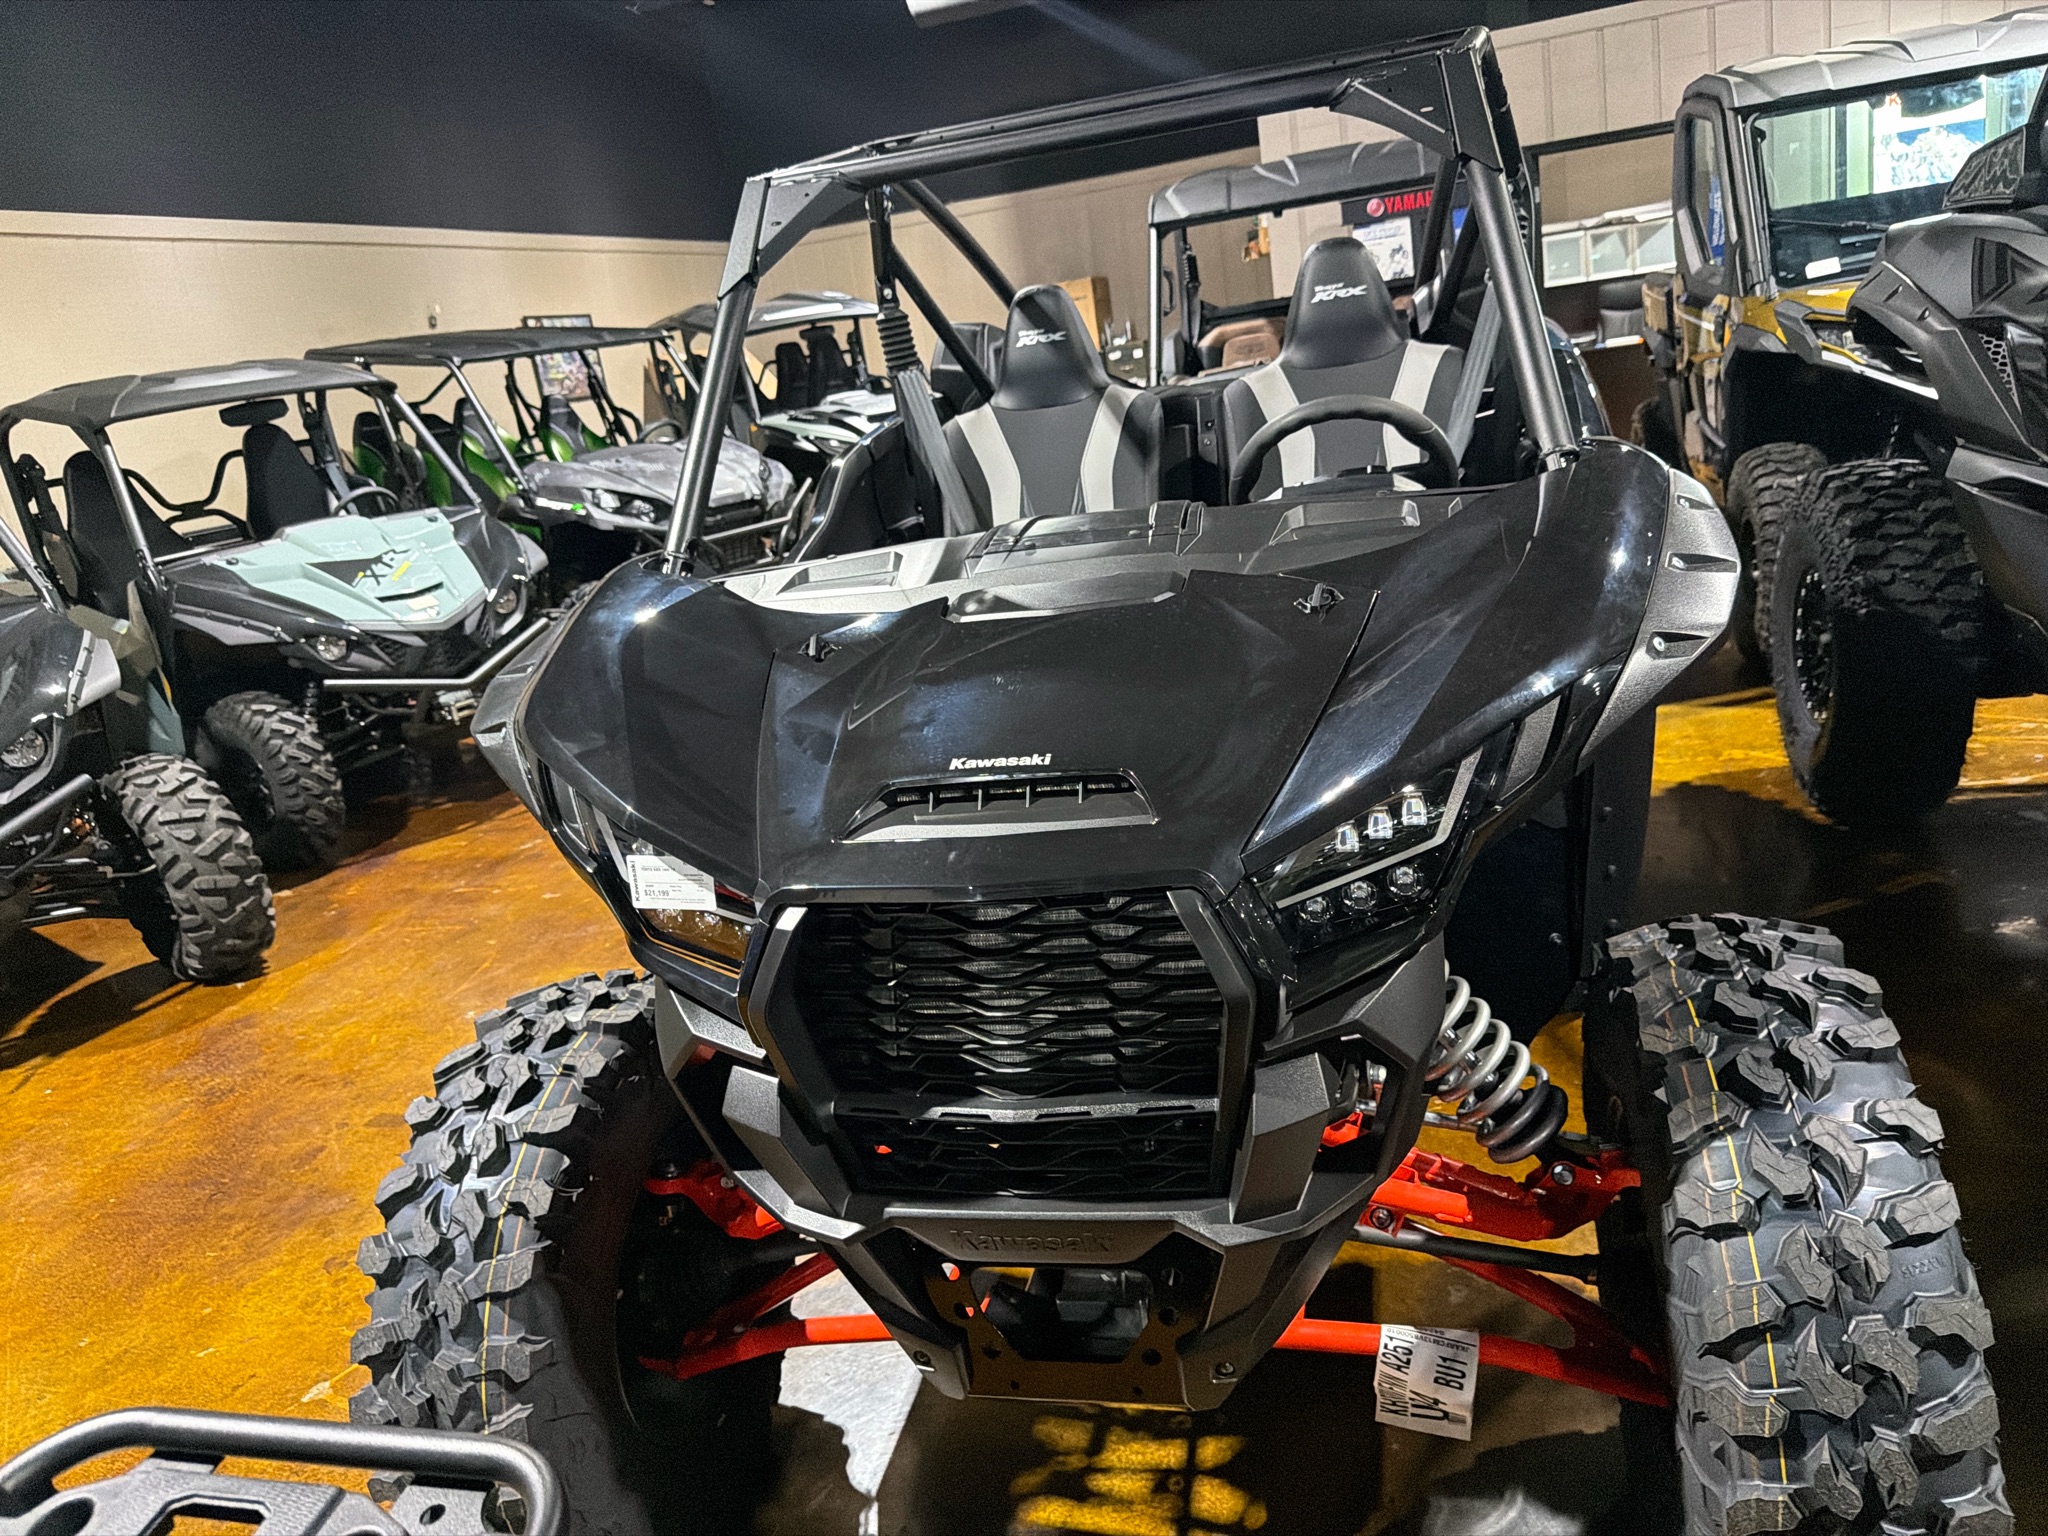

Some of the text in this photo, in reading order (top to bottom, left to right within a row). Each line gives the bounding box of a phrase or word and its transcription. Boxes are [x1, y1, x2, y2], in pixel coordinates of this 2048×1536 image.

[949, 753, 1052, 770] Kawasaki
[630, 860, 641, 902] Kawasaki
[644, 889, 670, 897] $21,199
[949, 1230, 1117, 1251] Kawasaki
[1433, 1355, 1468, 1391] BU1
